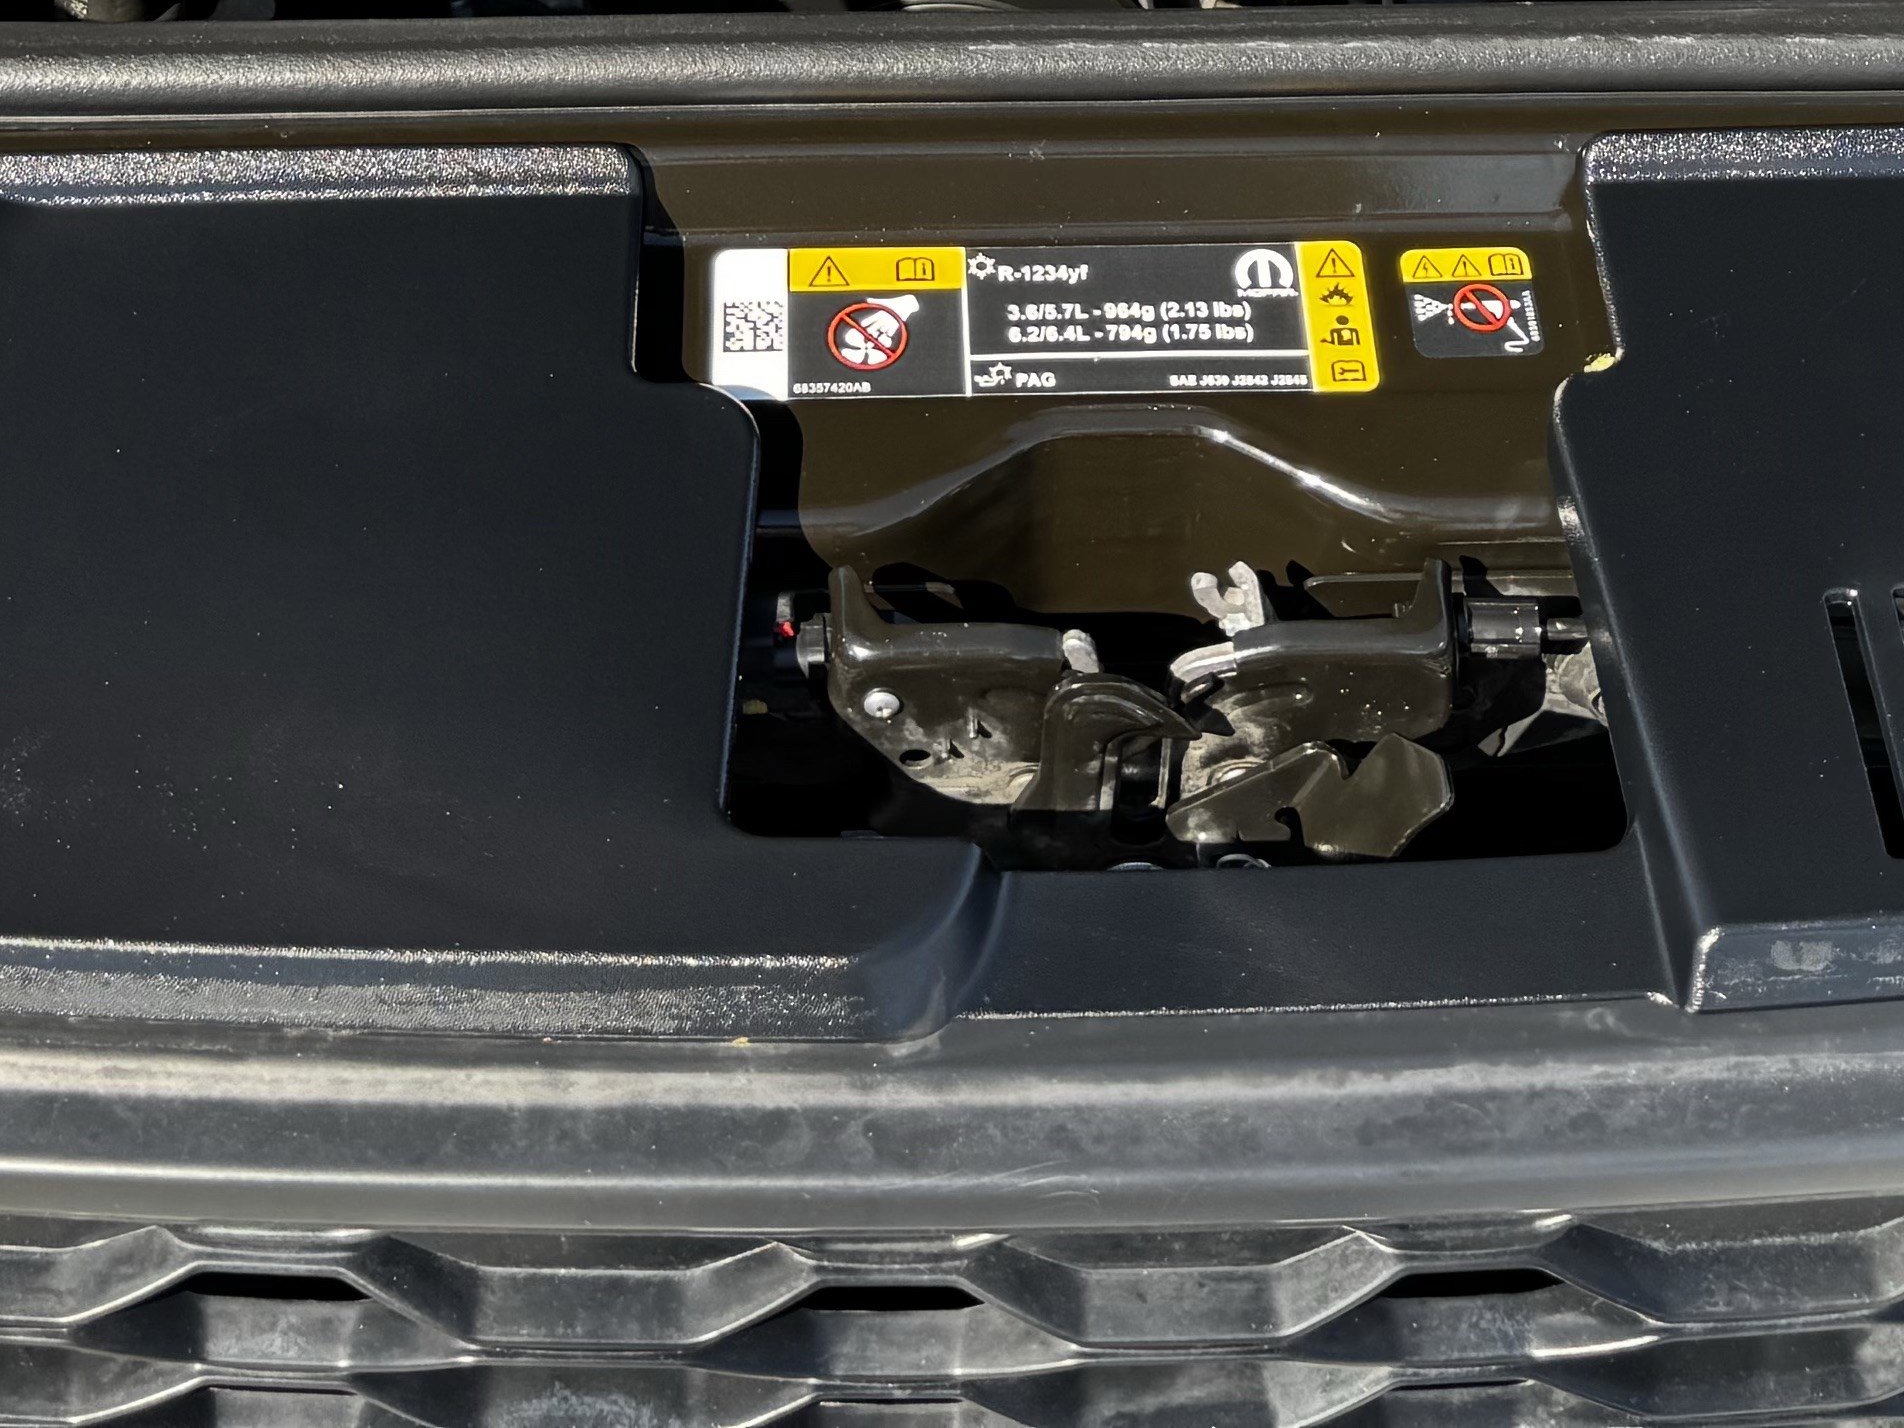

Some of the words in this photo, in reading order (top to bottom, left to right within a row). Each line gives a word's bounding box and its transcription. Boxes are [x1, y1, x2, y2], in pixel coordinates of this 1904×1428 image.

[998, 264, 1089, 284] R-1234yf
[1006, 303, 1089, 321] 3.6/5.7L
[1160, 301, 1209, 320] (2.13
[1213, 301, 1252, 320] lbs)
[1008, 324, 1091, 344] 6.2/6.4L
[1105, 323, 1157, 345] 794g
[1162, 323, 1211, 344] (1.75
[1215, 323, 1254, 343] lbs)
[1015, 372, 1057, 388] PAG
